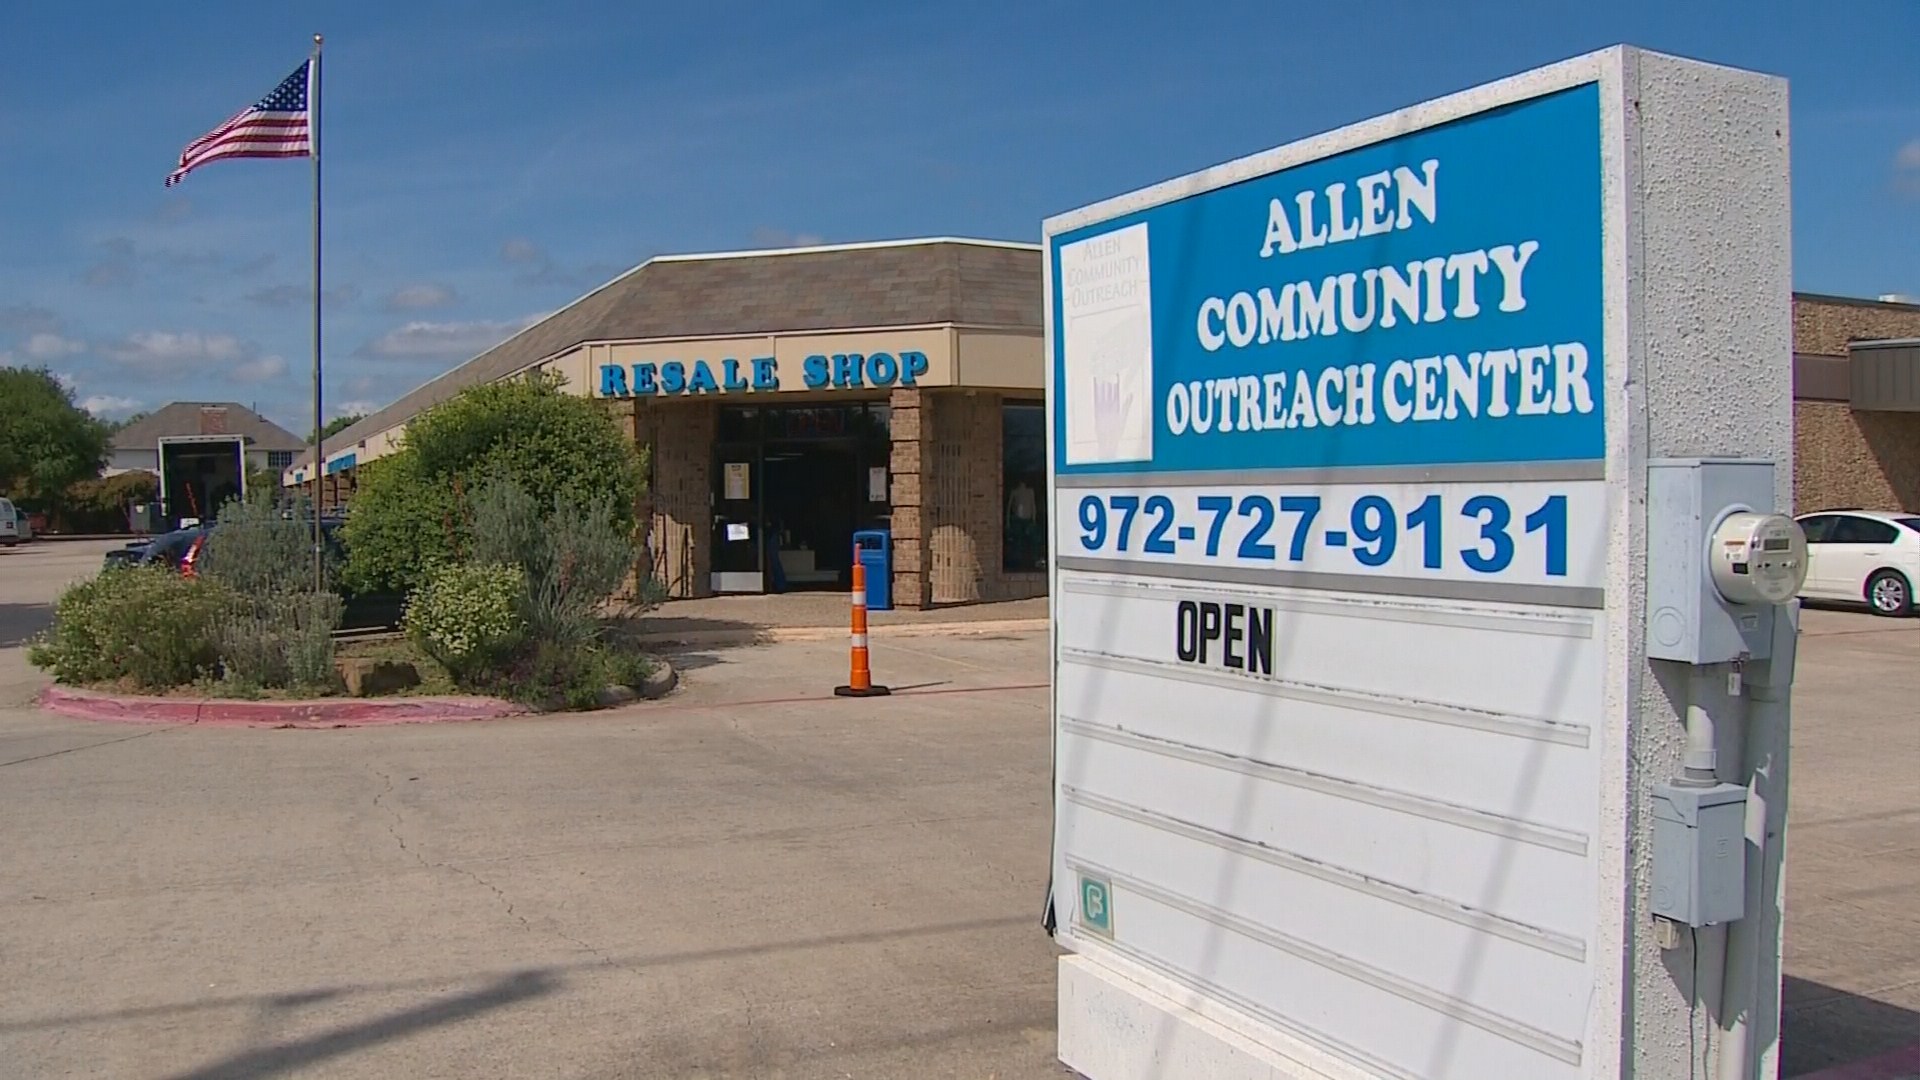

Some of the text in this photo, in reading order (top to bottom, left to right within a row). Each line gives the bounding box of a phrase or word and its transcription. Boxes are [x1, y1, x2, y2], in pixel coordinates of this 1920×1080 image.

[1260, 159, 1439, 258] ALLEN
[1069, 255, 1140, 287] COMMUNITY
[1084, 237, 1121, 261] ALLEN
[1072, 280, 1137, 308] OUTREACH
[1197, 240, 1539, 352] COMMUNITY
[600, 351, 929, 396] RESALE SHOP
[1166, 342, 1594, 435] OUTREACH CENTER
[1078, 494, 1568, 577] 972-727-9131
[1177, 600, 1273, 675] OPEN
